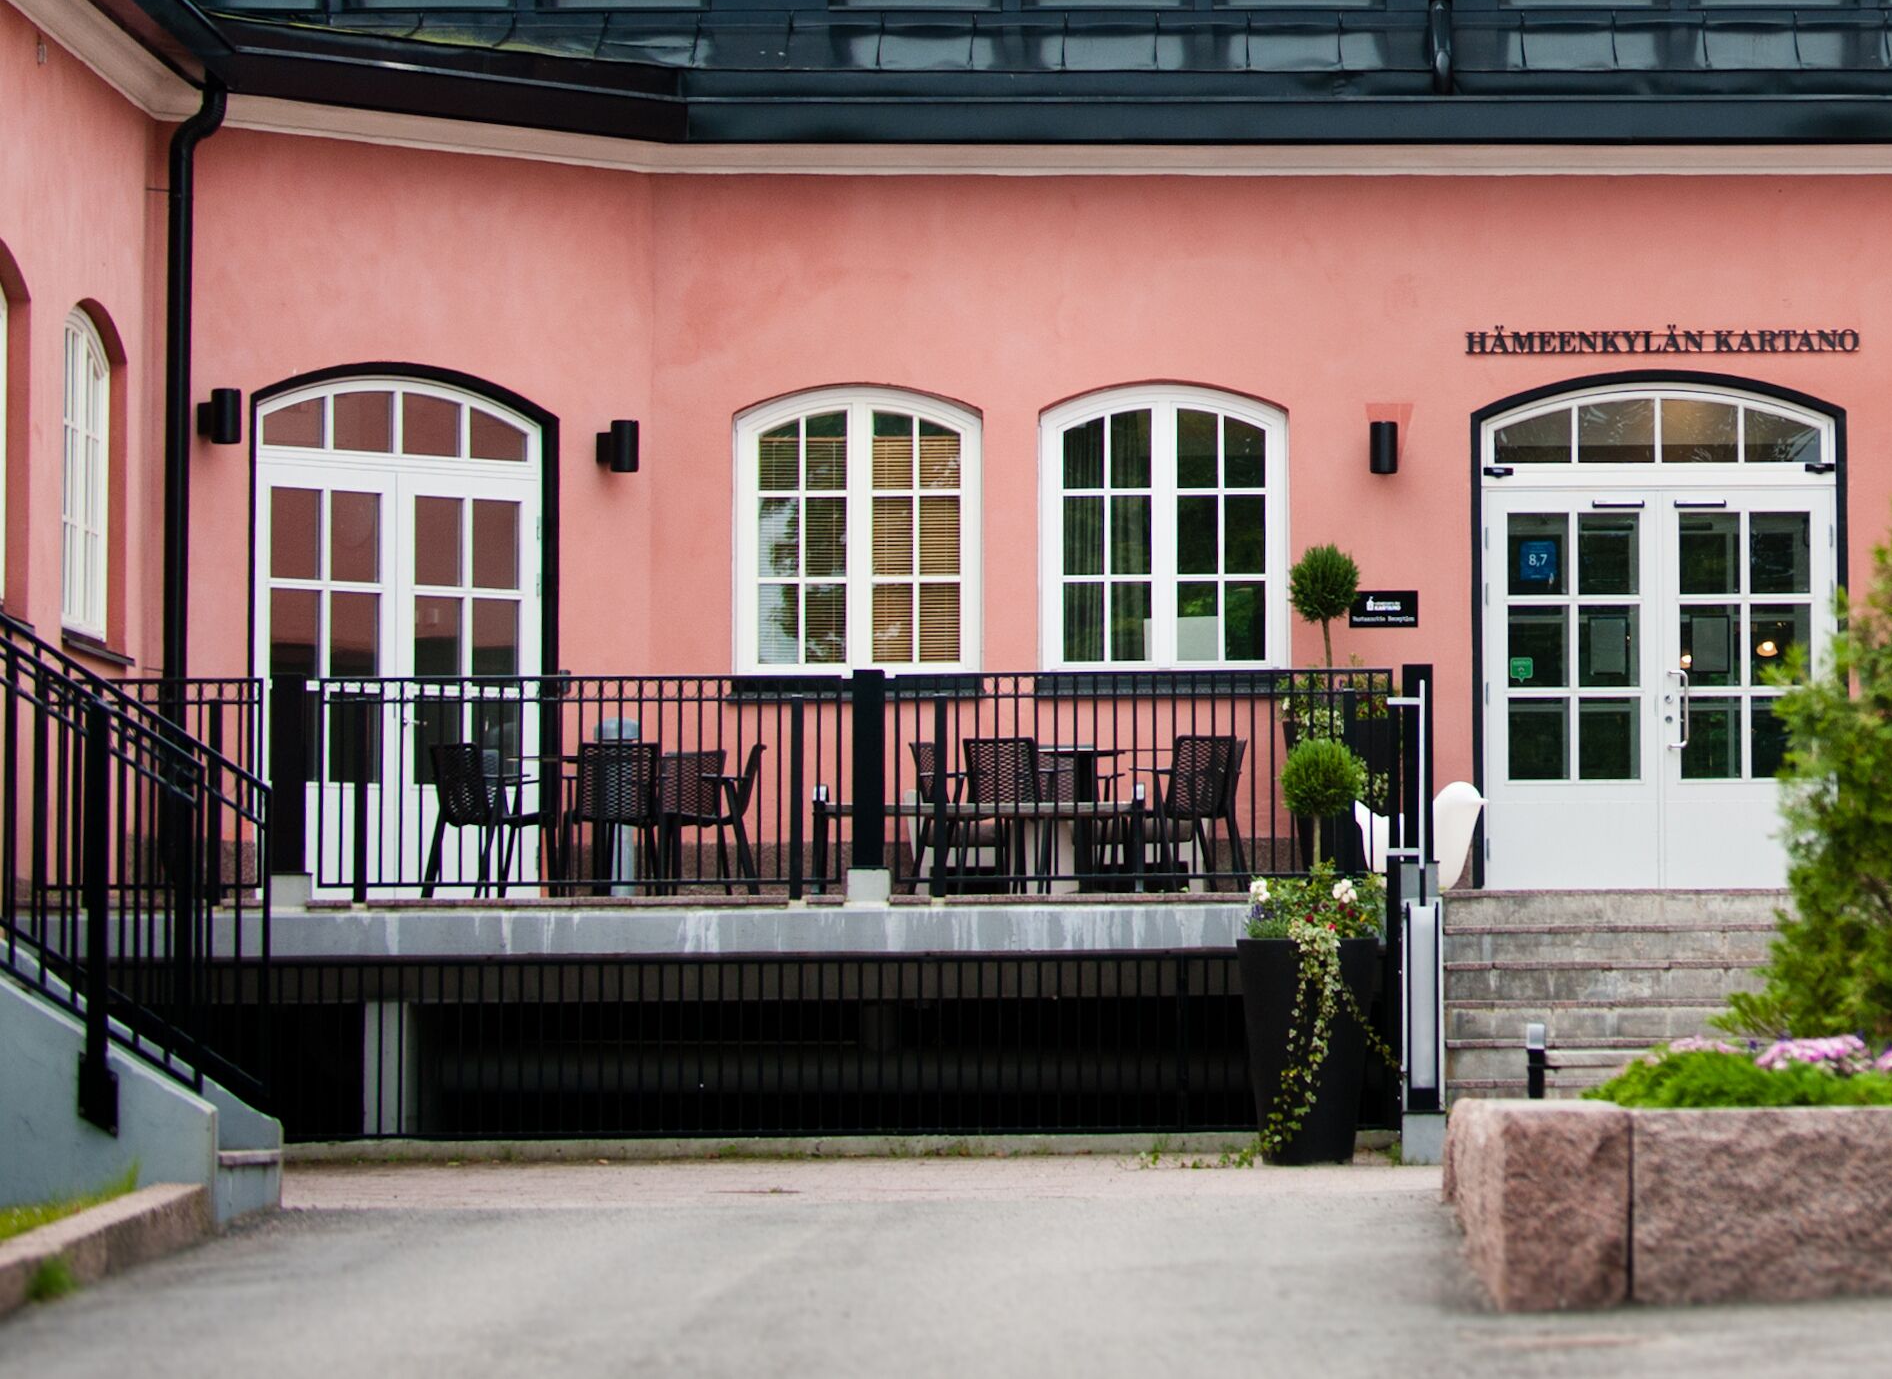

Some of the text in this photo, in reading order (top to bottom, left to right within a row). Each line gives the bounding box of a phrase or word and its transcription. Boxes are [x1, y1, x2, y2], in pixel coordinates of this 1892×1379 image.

[1465, 325, 1860, 353] HÄMEENKYLÄN KARTANO
[1529, 553, 1548, 567] 8,7
